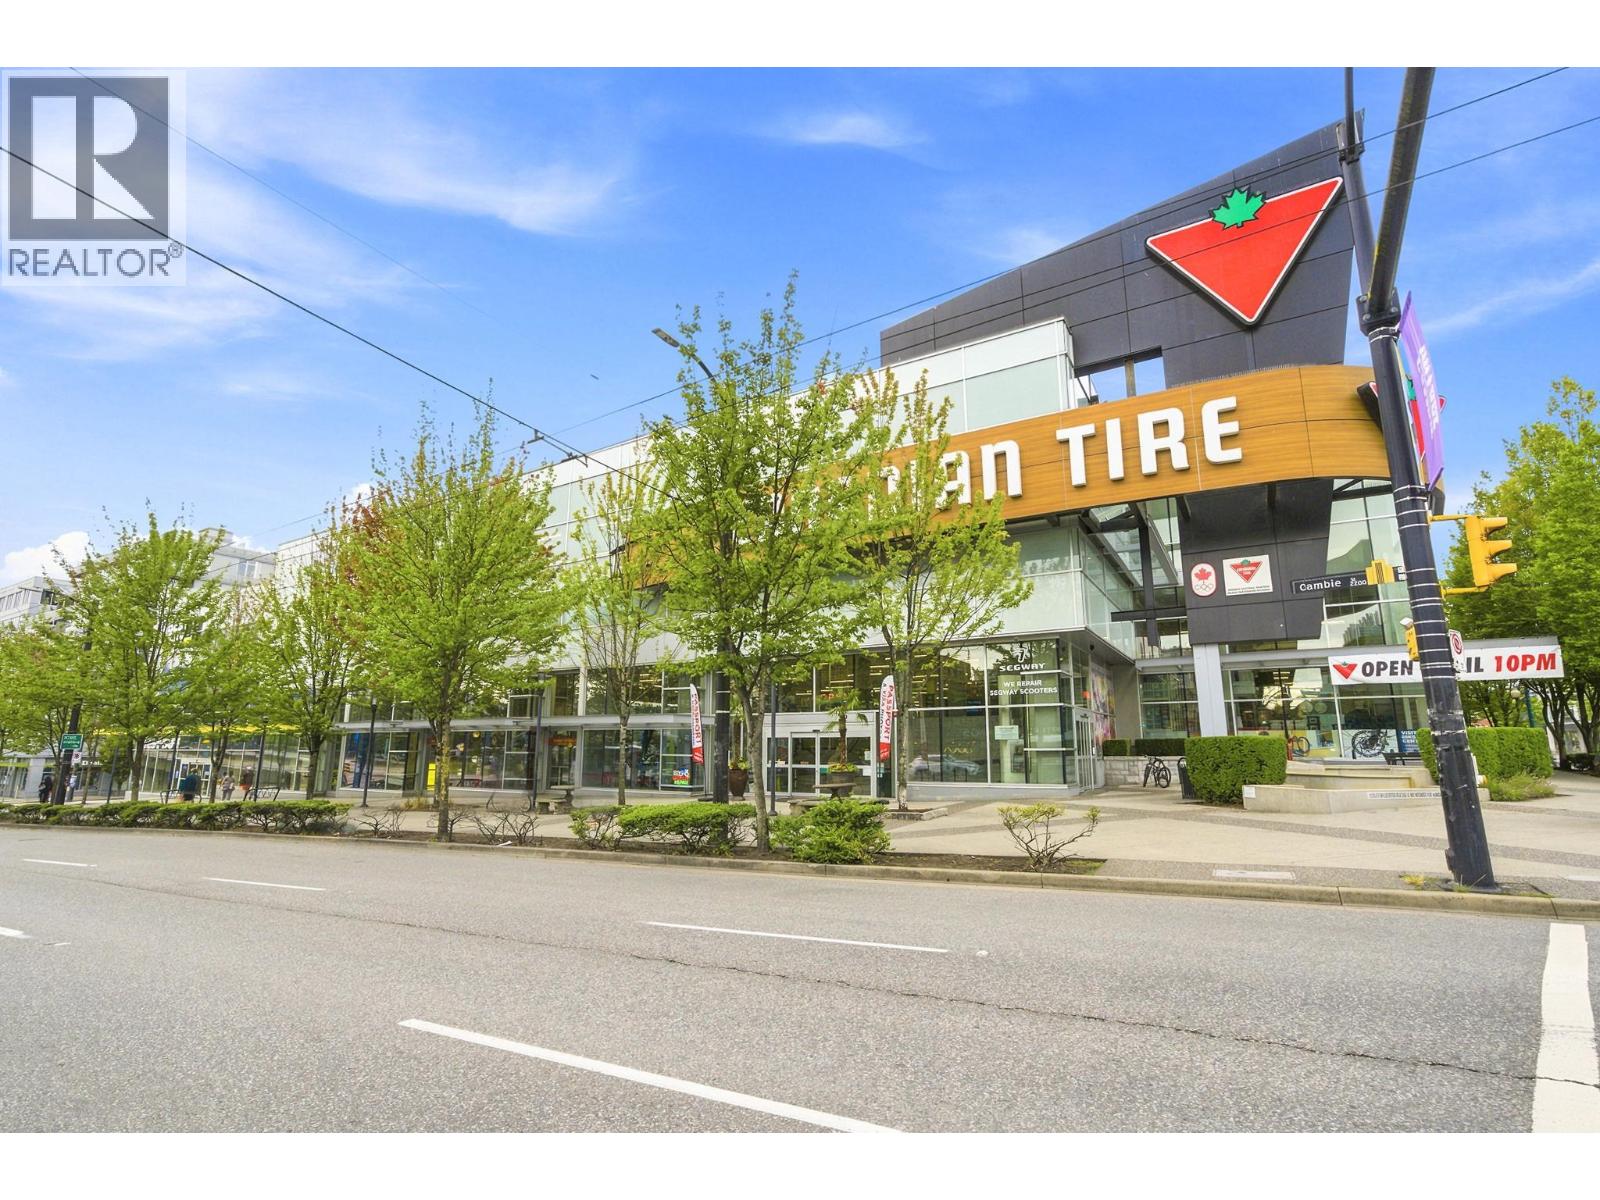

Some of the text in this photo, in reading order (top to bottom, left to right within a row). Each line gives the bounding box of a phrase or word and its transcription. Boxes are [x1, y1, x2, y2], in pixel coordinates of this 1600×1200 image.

[1056, 396, 1242, 487] TIRE
[1299, 579, 1341, 591] Cambie
[999, 663, 1045, 672] SEGWAY
[1361, 660, 1413, 677] OPEN
[1494, 653, 1557, 673] 10PM
[884, 685, 893, 741] PASSPORT
